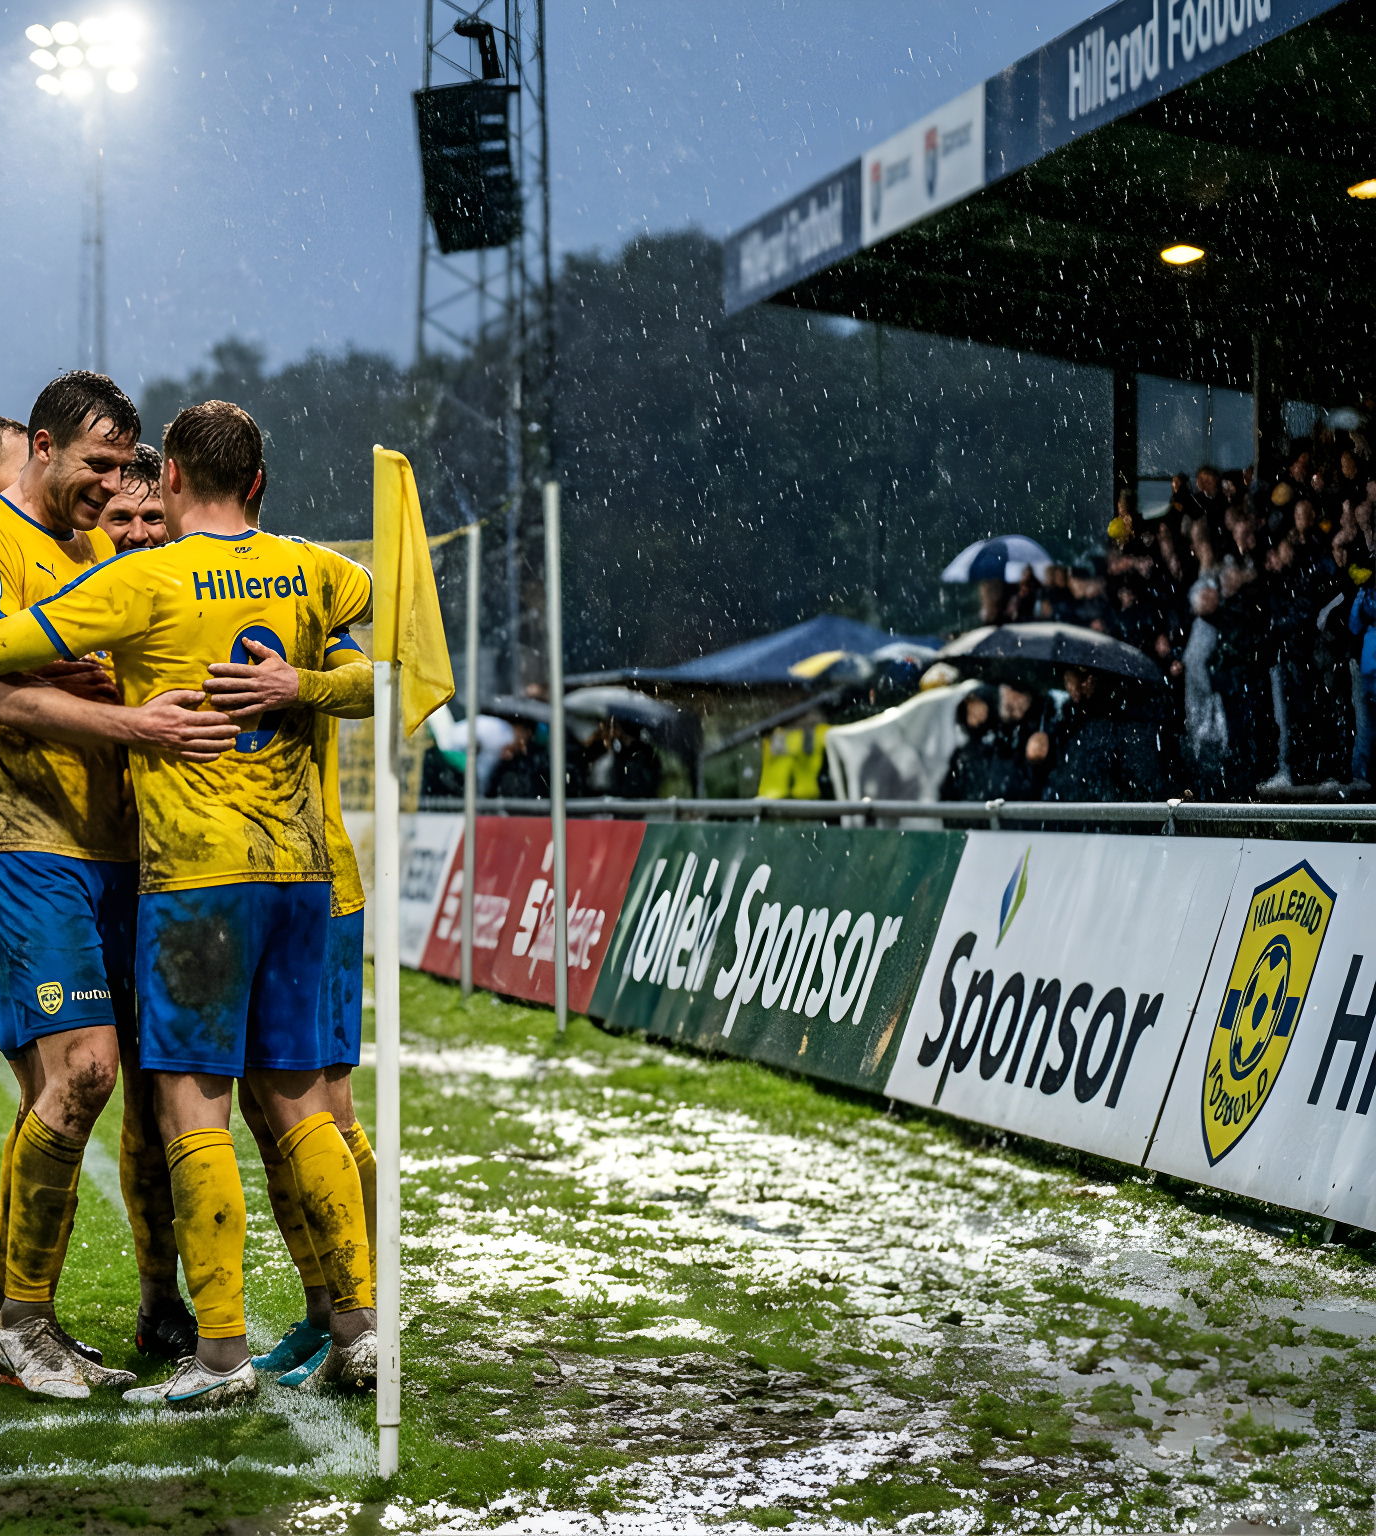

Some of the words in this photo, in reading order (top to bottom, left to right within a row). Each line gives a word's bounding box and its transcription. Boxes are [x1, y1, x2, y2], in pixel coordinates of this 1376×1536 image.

[1168, 0, 1271, 70] Fodbo
[192, 565, 309, 600] Hillerød
[714, 864, 903, 1038] Sponsor
[917, 931, 1165, 1109] Sponsor
